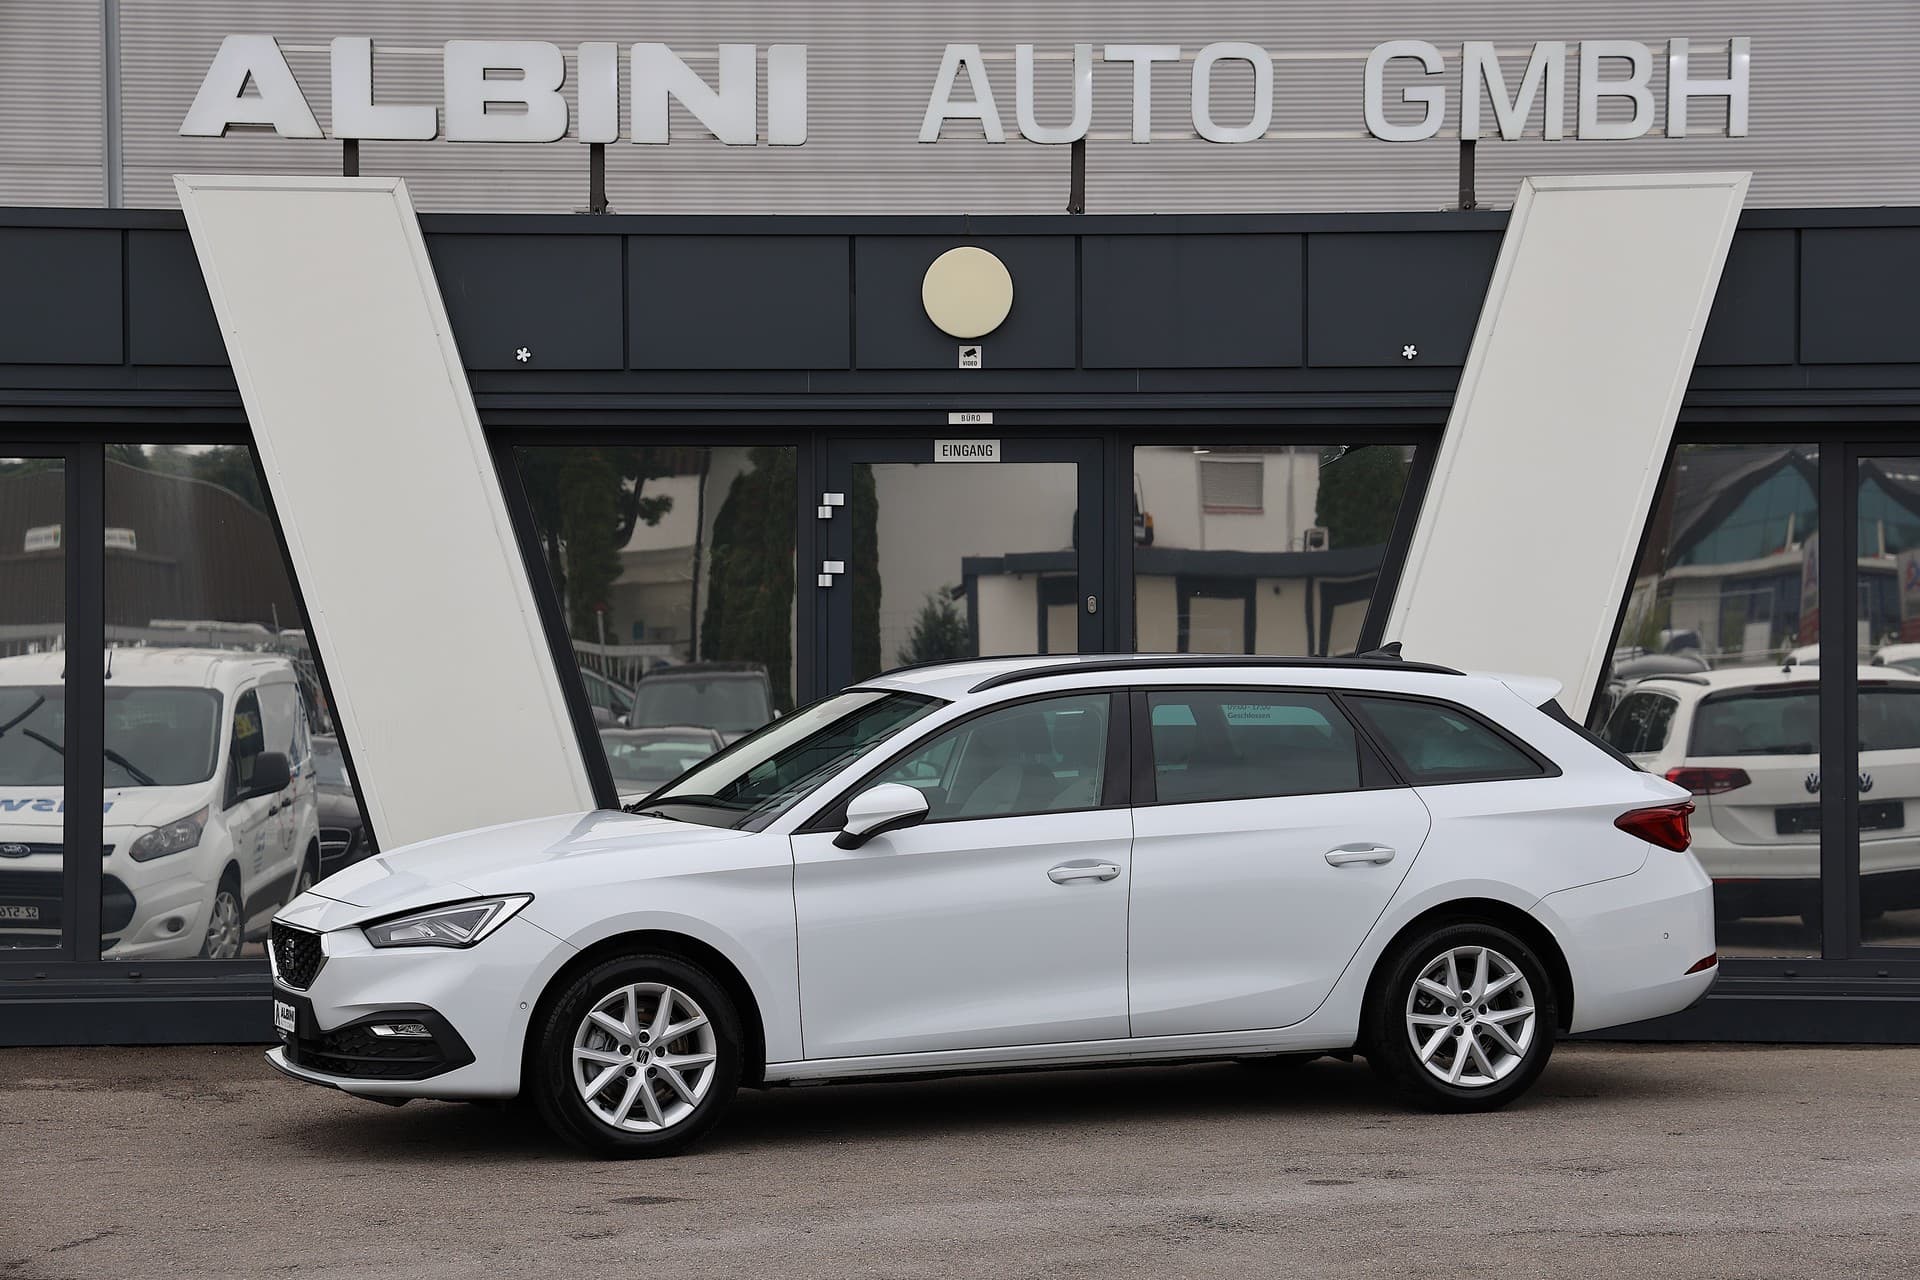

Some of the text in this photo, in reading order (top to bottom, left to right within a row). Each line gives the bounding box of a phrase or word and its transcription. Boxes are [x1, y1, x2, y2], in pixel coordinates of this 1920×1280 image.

[179, 34, 1752, 146] ALBINI AUTO GMBH
[961, 414, 981, 422] BÜRO
[942, 444, 993, 457] EINGANG
